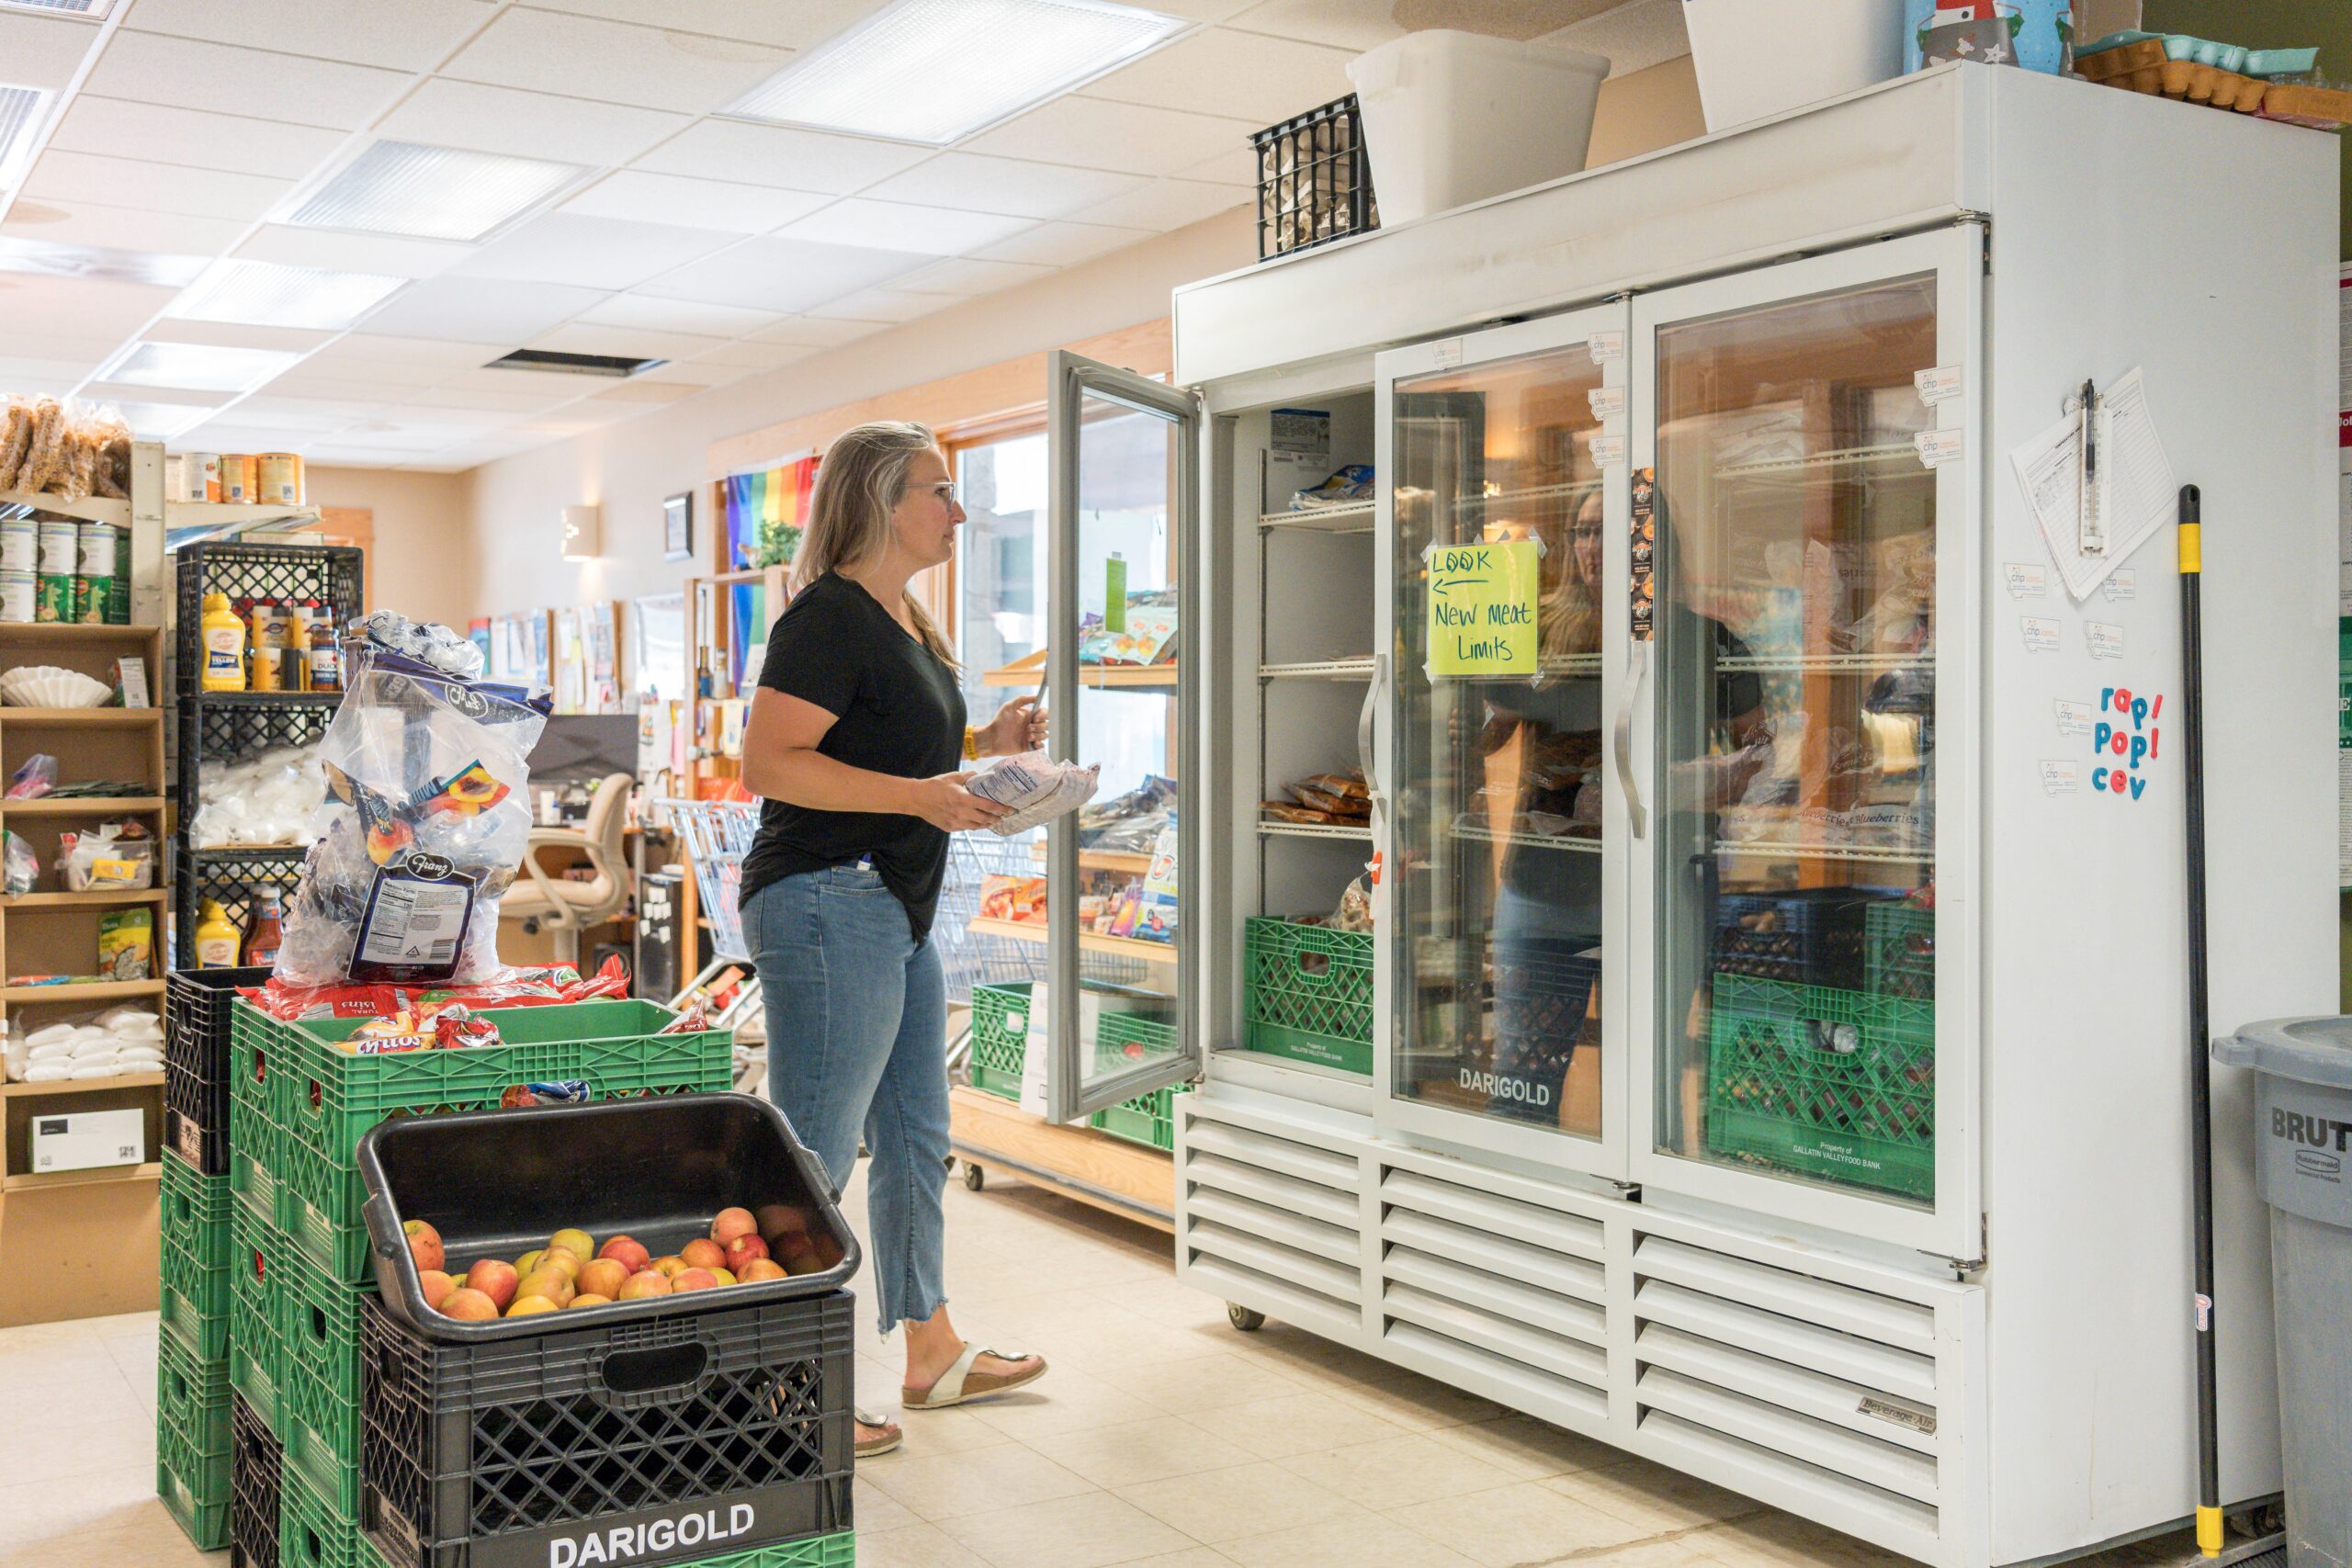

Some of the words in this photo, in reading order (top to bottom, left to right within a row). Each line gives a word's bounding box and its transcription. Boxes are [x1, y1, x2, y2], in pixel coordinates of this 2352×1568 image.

[1922, 379, 1938, 389] chp
[1923, 442, 1939, 452] chp
[1433, 550, 1493, 573] LOOK
[2011, 573, 2026, 582] chp
[1435, 602, 1477, 627] New
[2027, 626, 2041, 637] chp
[2093, 632, 2106, 641] chp
[1458, 635, 1513, 660] Limits
[2060, 711, 2073, 720] chp
[2045, 771, 2058, 779] chp
[2091, 767, 2146, 801] cev
[413, 854, 448, 877] Franz
[1460, 1067, 1550, 1106] DARIGOLD
[2272, 1107, 2352, 1153] BRUT
[1792, 1145, 1822, 1157] GALLATIN
[1862, 1159, 1881, 1169] BANK
[1820, 1142, 1845, 1155] Property
[2297, 1154, 2338, 1169] Rubbermaid
[550, 1504, 754, 1568] DARIGOLD
